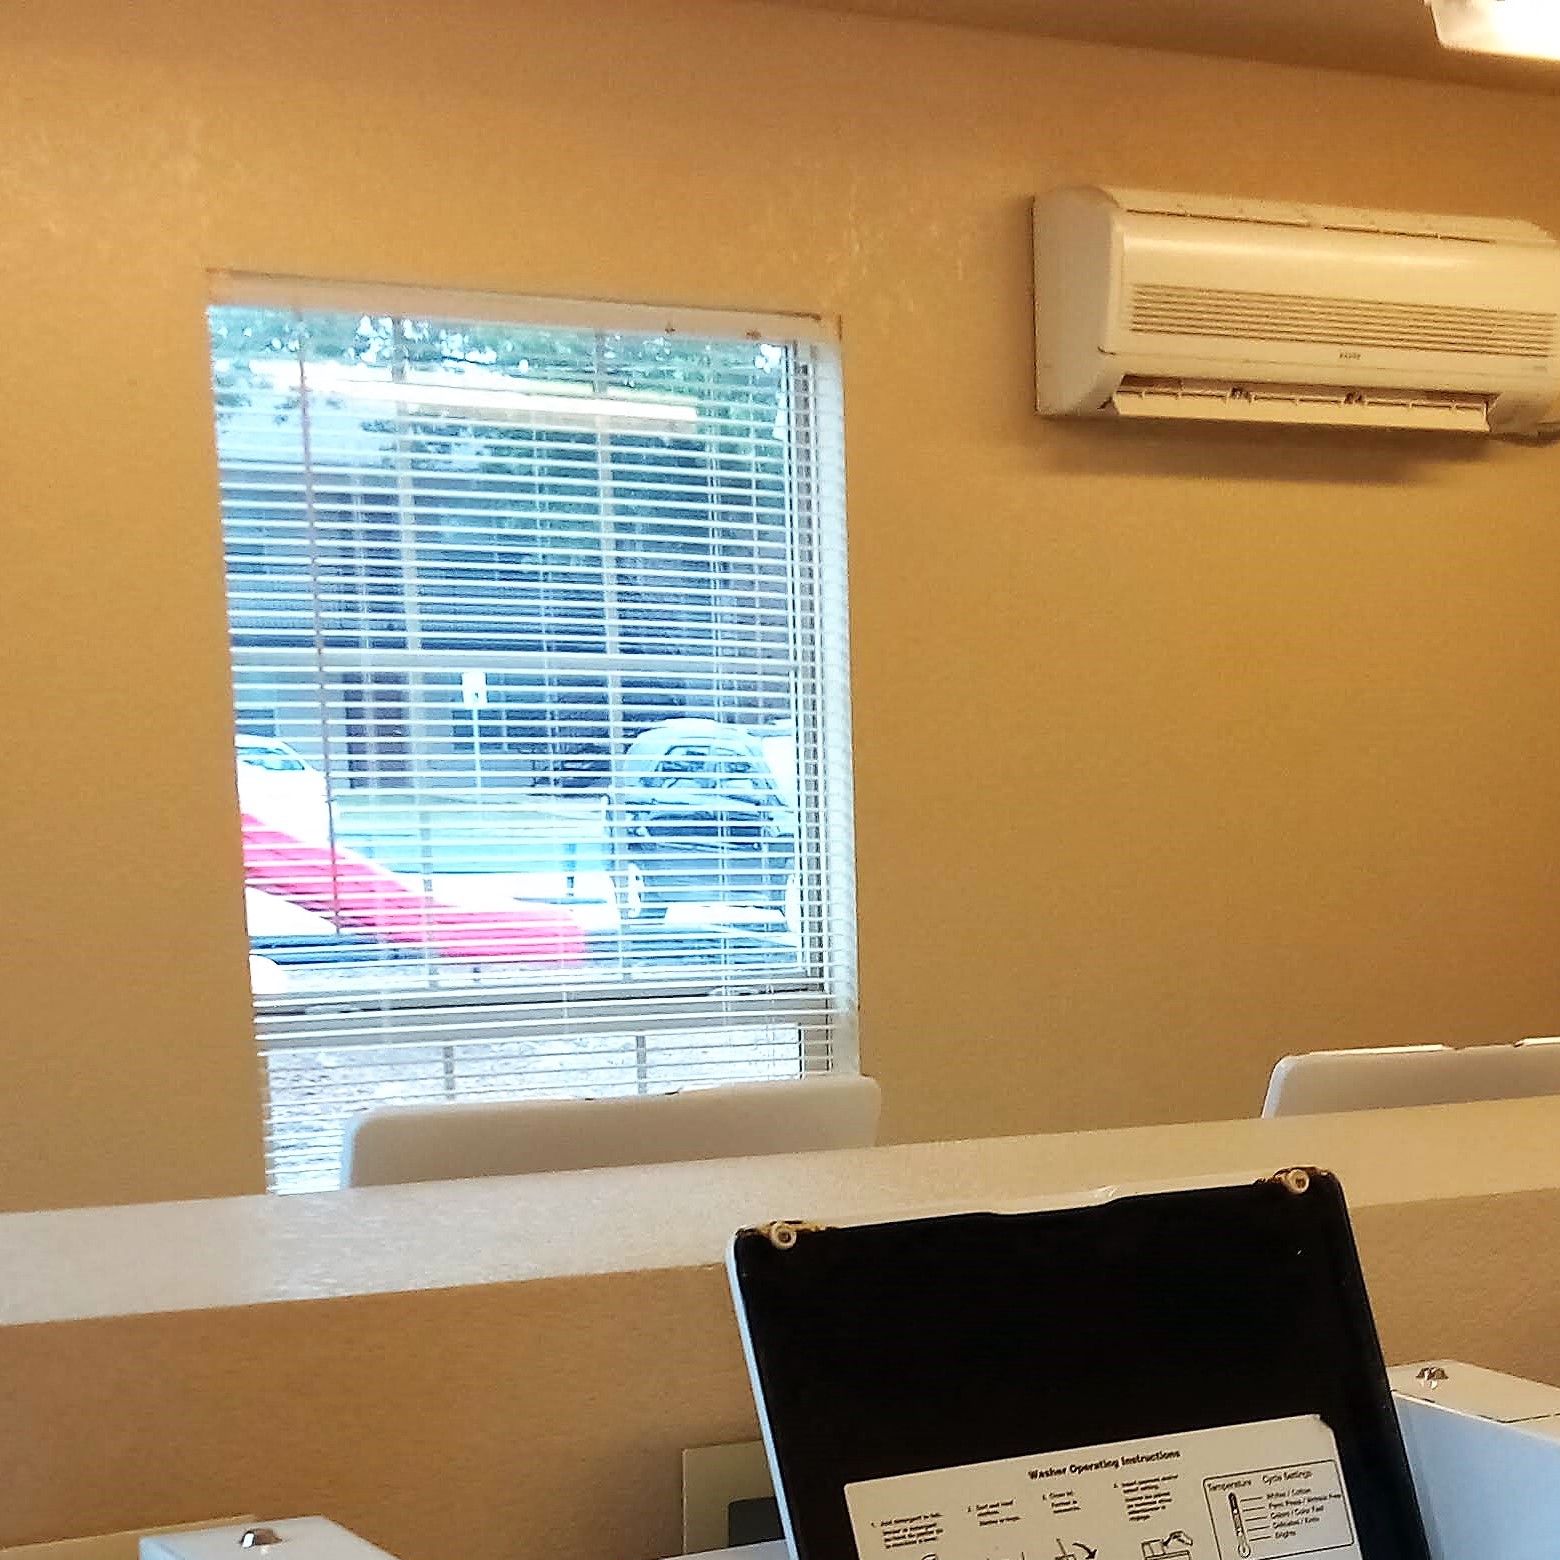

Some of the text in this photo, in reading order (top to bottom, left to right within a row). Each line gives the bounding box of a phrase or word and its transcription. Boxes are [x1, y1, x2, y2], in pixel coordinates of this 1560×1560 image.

[1028, 1450, 1181, 1480] Washer Operating Instructions
